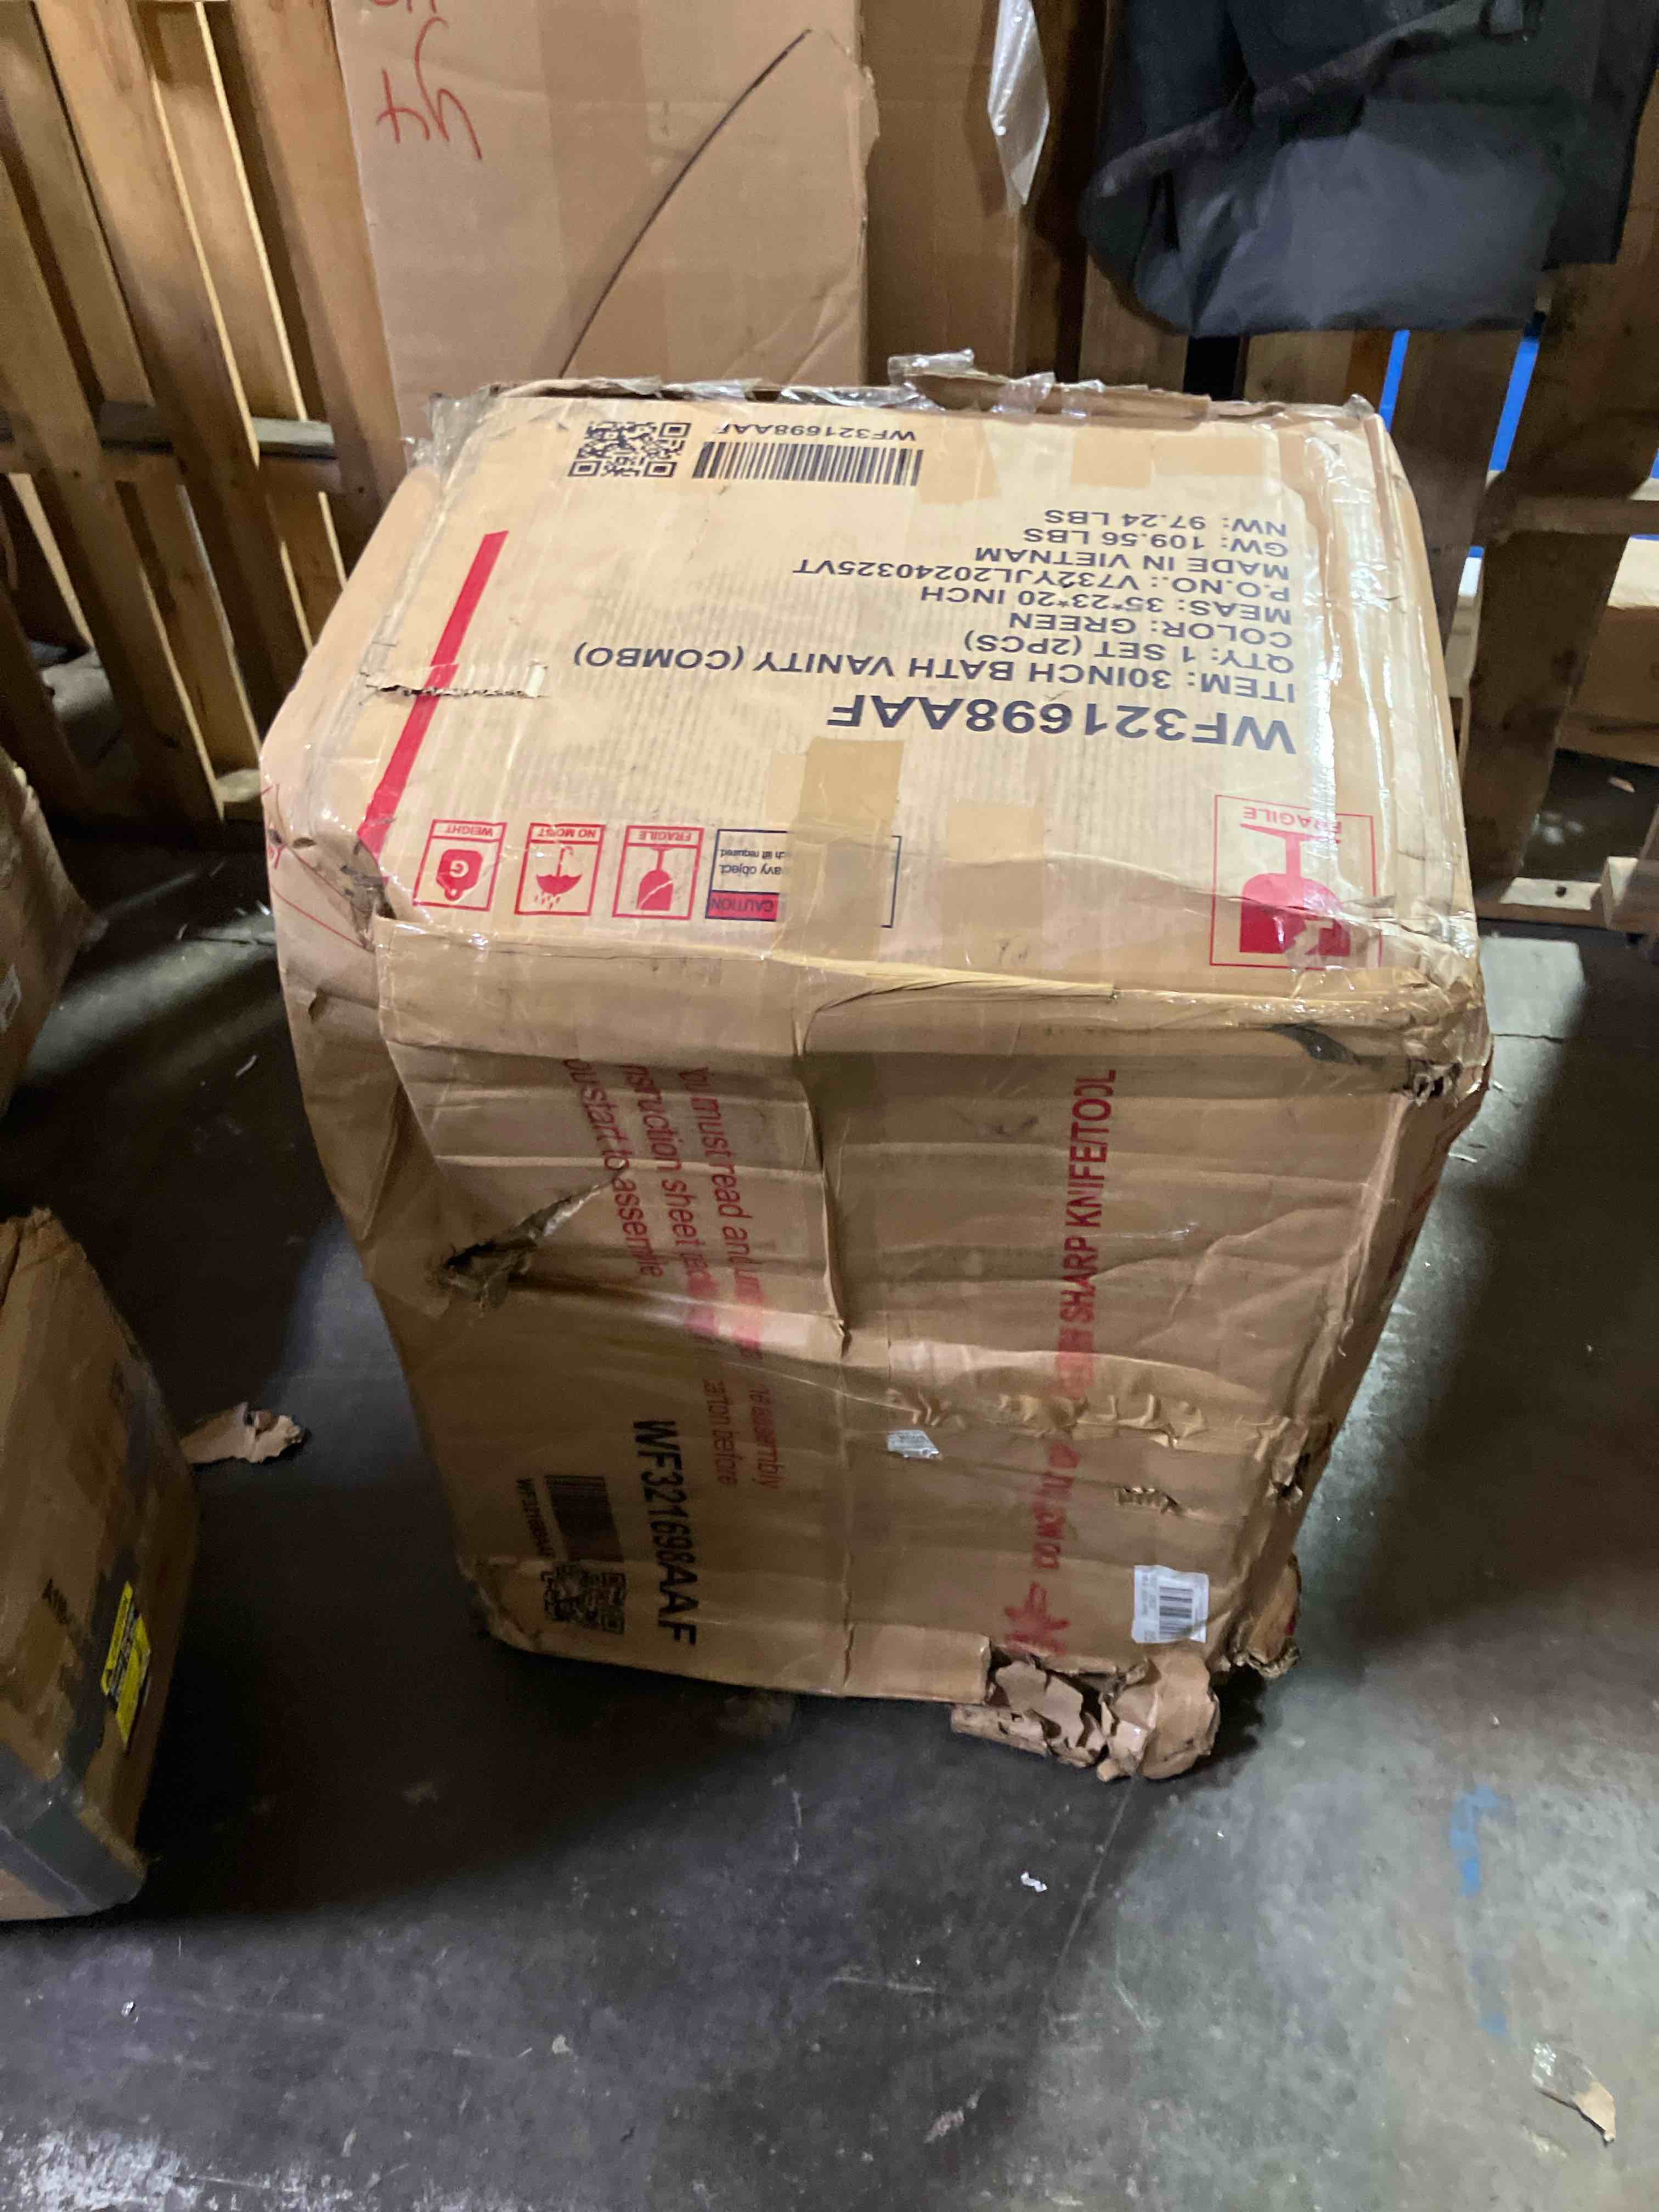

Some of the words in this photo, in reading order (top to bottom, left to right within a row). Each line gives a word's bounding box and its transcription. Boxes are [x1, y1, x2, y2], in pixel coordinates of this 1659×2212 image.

[1045, 509, 1110, 526] LBS
[1121, 513, 1206, 530] 97.24
[1221, 517, 1287, 538] NW:
[1023, 528, 1089, 545] LBS
[1101, 532, 1205, 550] 109.56
[1221, 537, 1288, 558] GW:
[974, 546, 1131, 569] VIETNAM
[1143, 555, 1175, 572] IN
[1186, 557, 1290, 580] MADE
[793, 558, 1139, 591] V732YJL20240325VT
[920, 586, 1005, 605] INCH
[1151, 575, 1290, 601] P.O.NO.:
[1009, 612, 1137, 635] GREEN
[1177, 599, 1291, 625] MEAS:
[964, 629, 1082, 657] (2PCS)
[1150, 620, 1293, 649] COLOR:
[573, 641, 745, 672] (COMBO)
[1094, 641, 1166, 662] SET
[1182, 646, 1196, 663] 1
[1211, 647, 1295, 674] QTY:
[752, 651, 895, 678] VANITY
[908, 657, 1015, 682] BATH
[1028, 662, 1172, 690] 30INCH
[1187, 672, 1296, 704] ITEM:
[826, 695, 1297, 755] WF321698AAF
[445, 824, 494, 837] WEIGHT
[574, 829, 597, 838] NO
[638, 830, 693, 843] FRAGILE
[449, 859, 470, 878] G
[710, 896, 775, 913] CAUTION
[579, 1086, 629, 1142] start
[690, 1096, 738, 1159] must
[601, 1147, 633, 1171] to
[712, 1164, 753, 1221] read
[661, 1178, 706, 1247] sheet
[1059, 1235, 1098, 1324] SHARP
